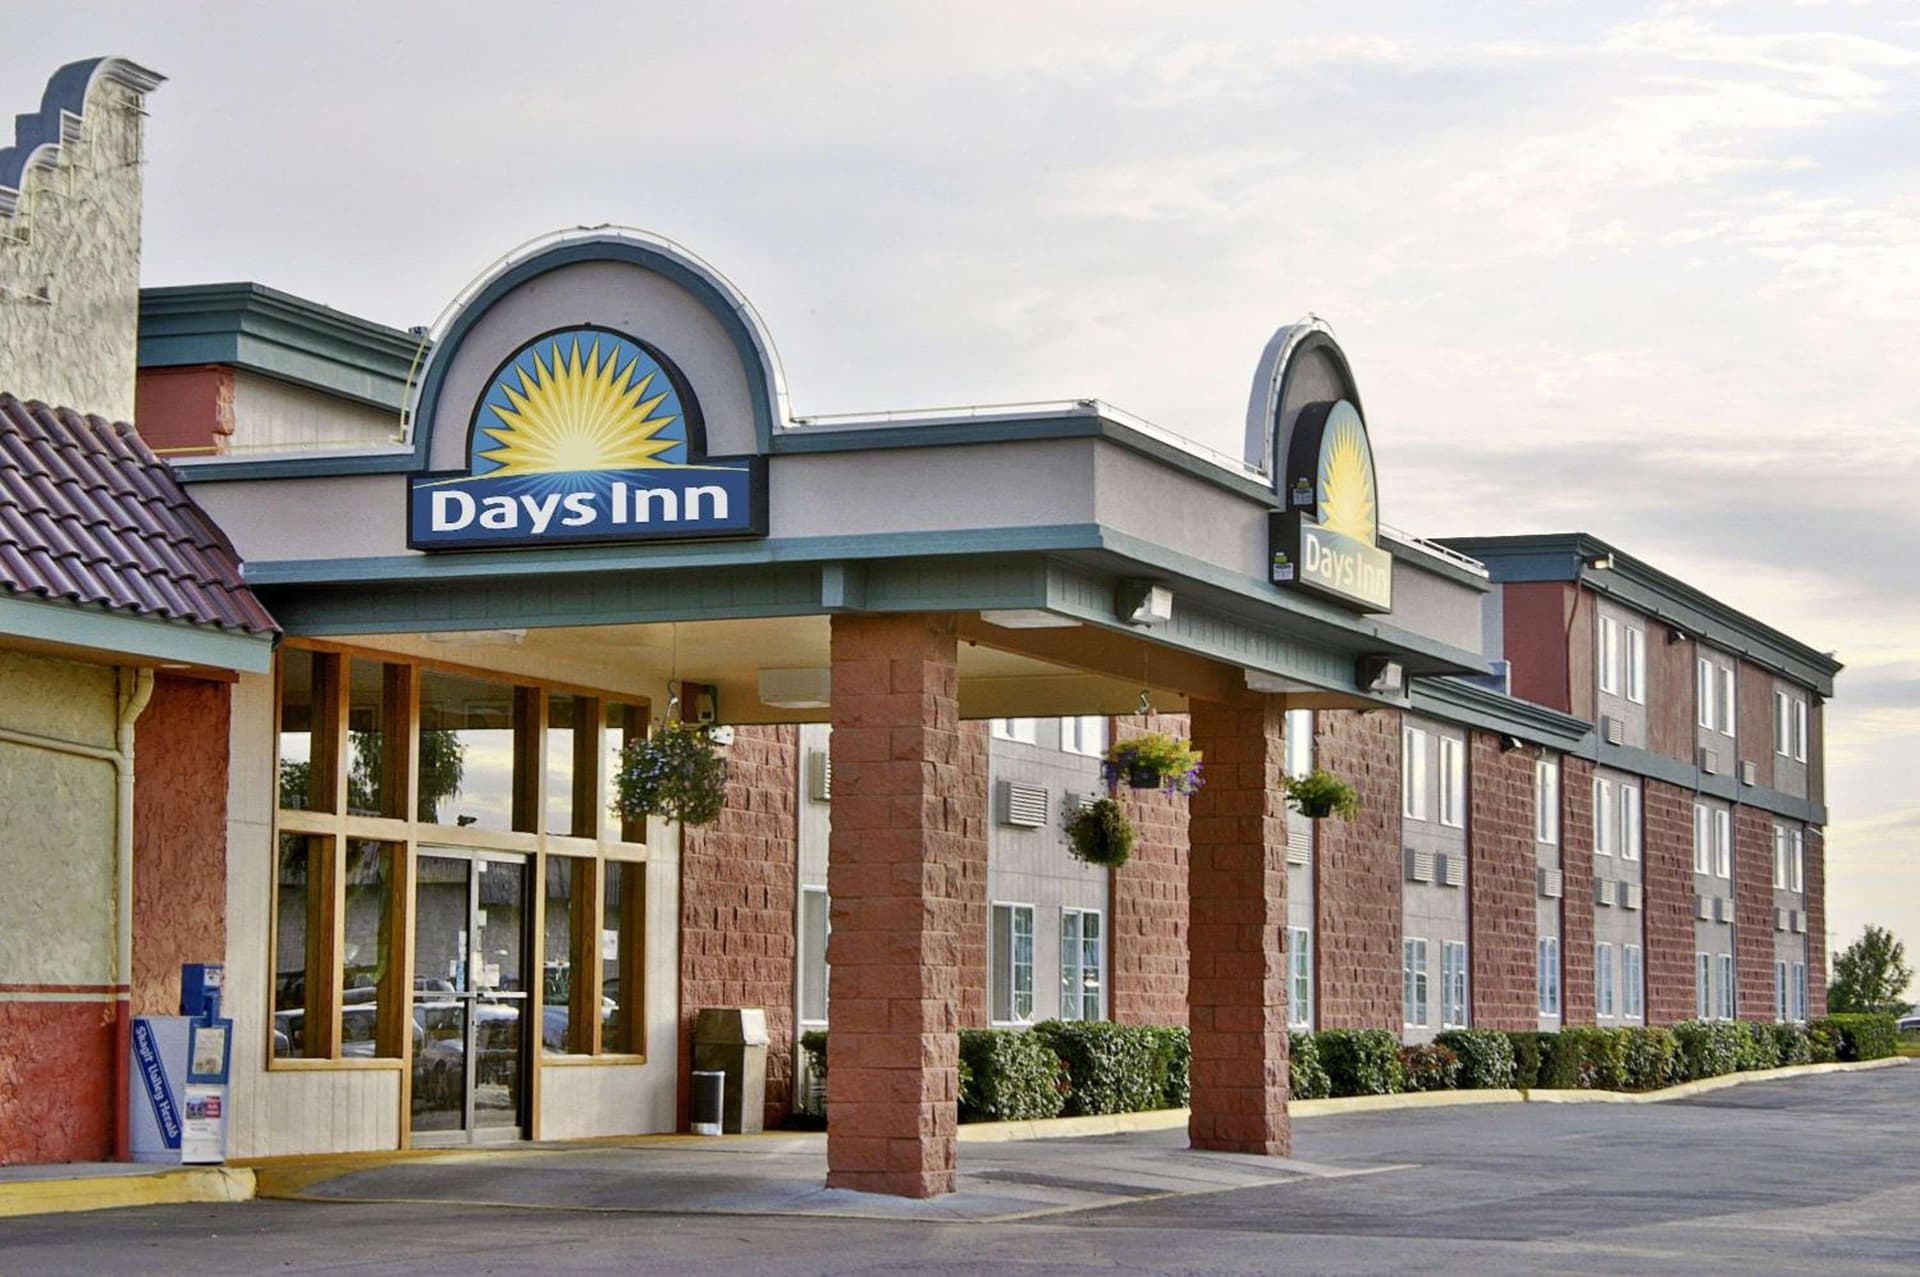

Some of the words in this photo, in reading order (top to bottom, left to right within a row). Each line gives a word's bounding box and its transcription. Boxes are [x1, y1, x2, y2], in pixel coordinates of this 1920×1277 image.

[431, 490, 598, 534] Days
[612, 482, 729, 524] Inn
[1306, 533, 1354, 588] Days
[1358, 553, 1387, 600] Inn
[136, 1025, 154, 1062] Skagit
[148, 1063, 164, 1101] Valley
[160, 1100, 178, 1138] Herald
